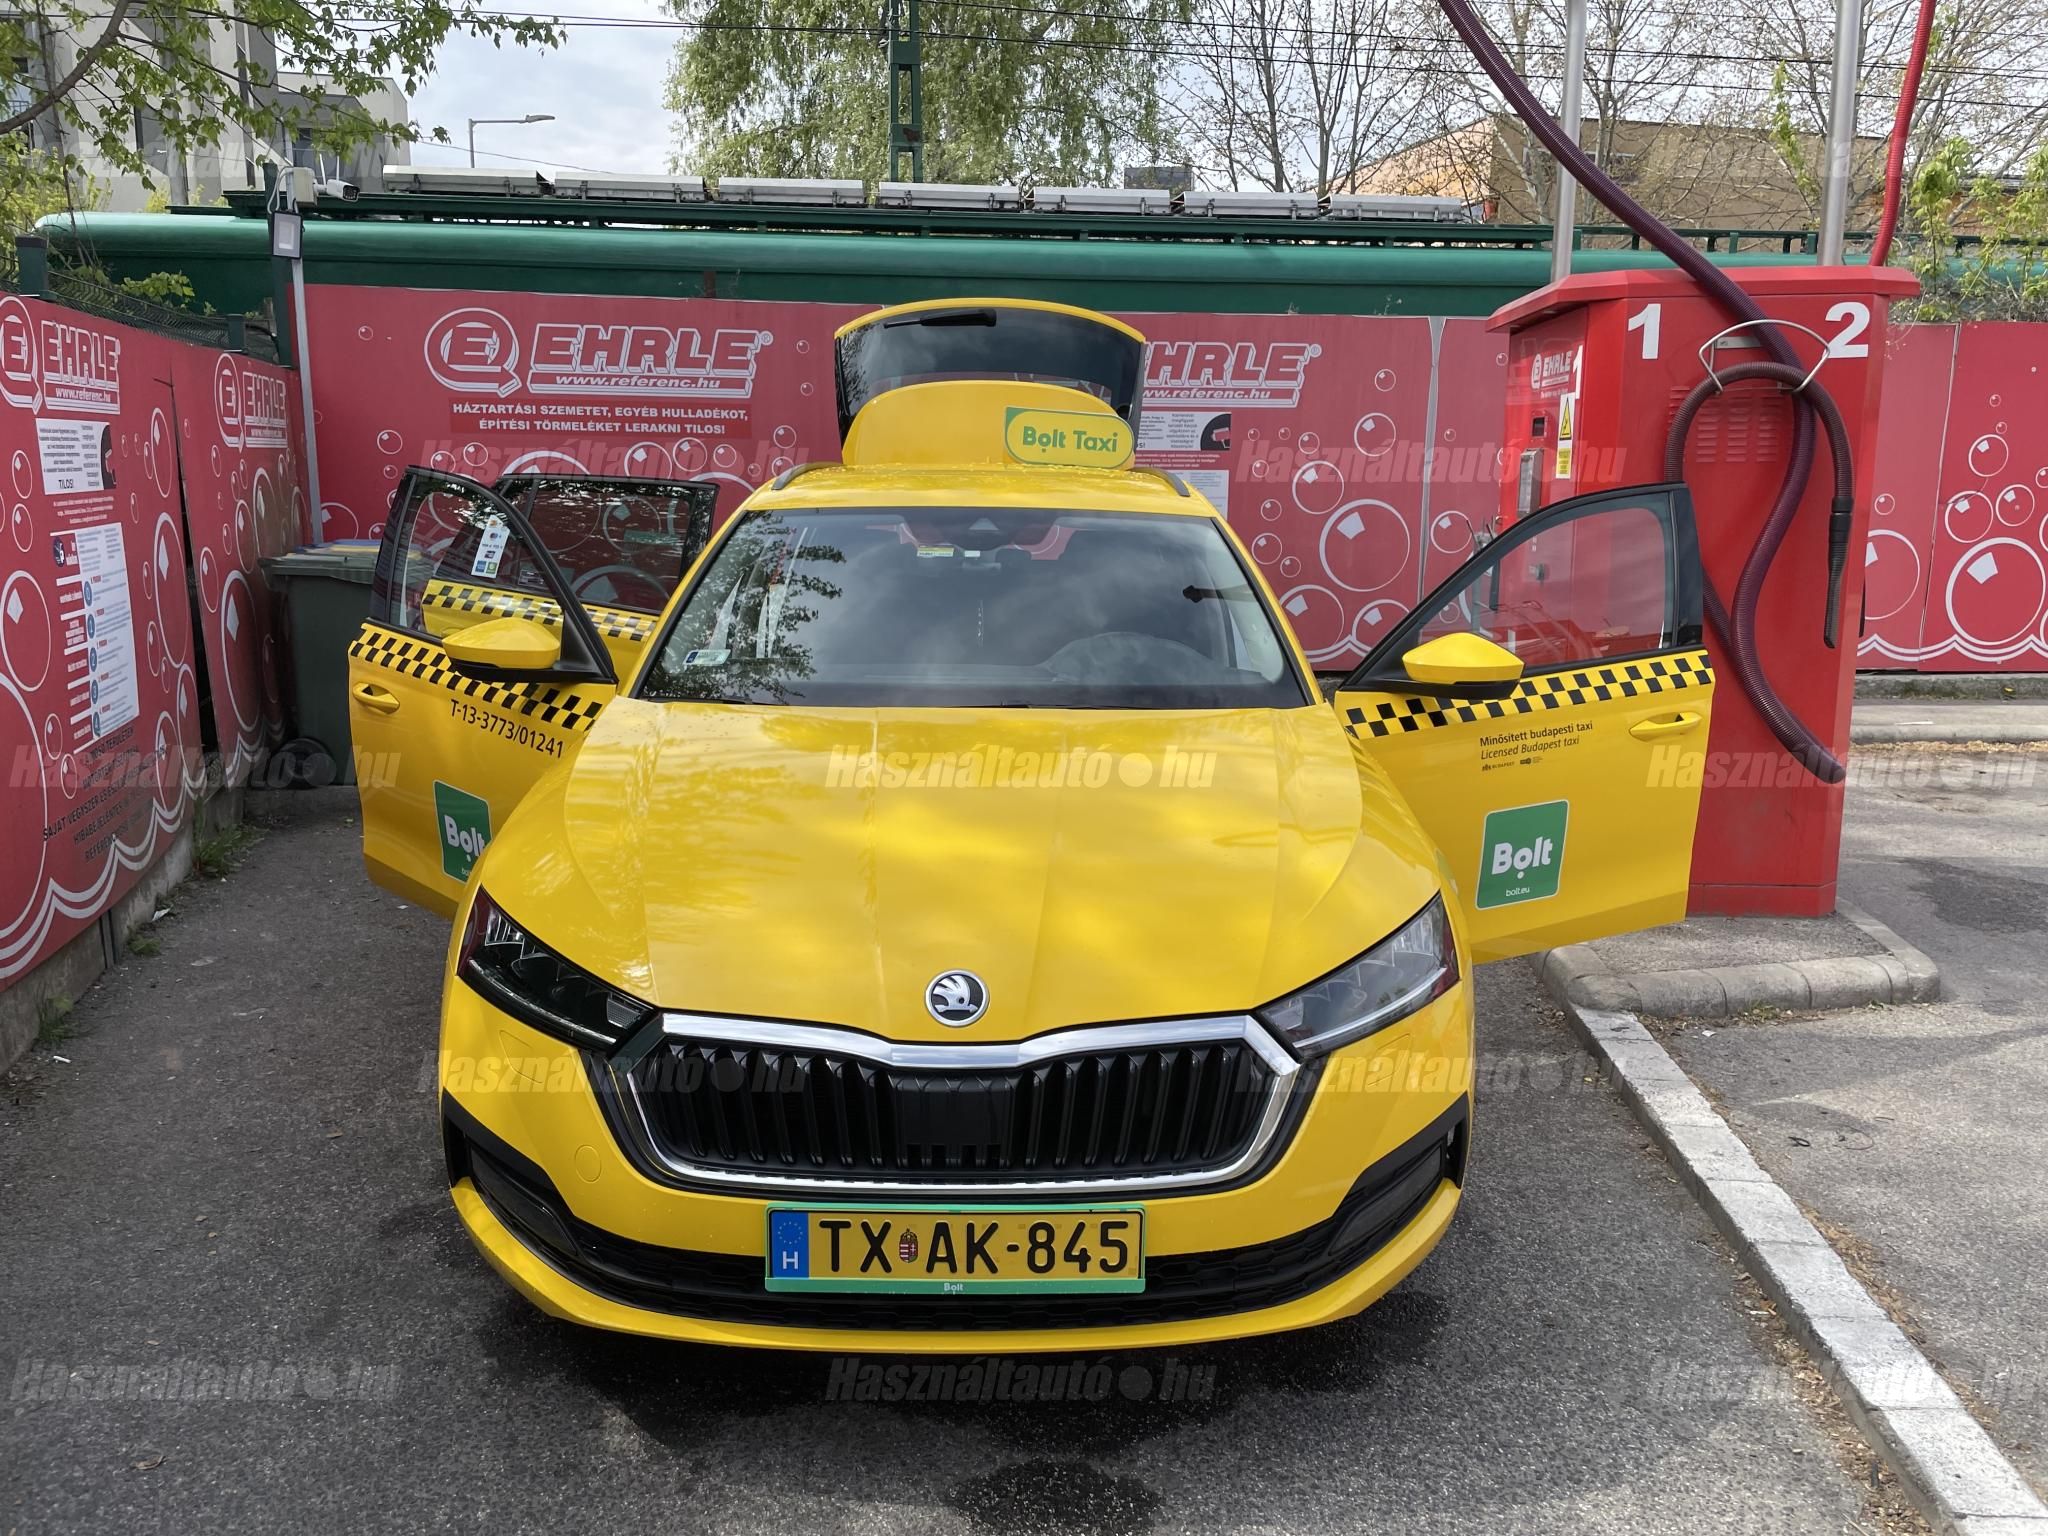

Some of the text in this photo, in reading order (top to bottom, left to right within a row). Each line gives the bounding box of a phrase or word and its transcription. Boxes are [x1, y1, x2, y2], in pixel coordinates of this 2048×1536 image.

[1627, 303, 1662, 360] 1
[1824, 302, 1870, 359] 2
[41, 320, 119, 388] EHRLE
[531, 323, 761, 376] EHRLE
[1144, 342, 1310, 388] HRLE
[1543, 350, 1573, 377] EHRLE
[556, 374, 721, 390] www.referenc.hu
[1573, 345, 1584, 400] 1
[453, 402, 749, 421] HÁZTARTÁSI SZEMETET, EGYÉB HULLADÉKOT,
[1142, 388, 1271, 400] ww.referenc.hu
[479, 418, 726, 435] ÉPÍTÉSI TÖRMELÉKET LERAKNI TILOS!
[1023, 426, 1119, 453] Bolt Taxi
[451, 700, 564, 759] T-13-3773/01241
[1530, 724, 1574, 738] budapesti
[1577, 720, 1593, 732] taxi
[1481, 735, 1580, 760] Licensed Budapest taxi
[444, 814, 486, 862] Bolt
[1492, 836, 1553, 880] Bolt
[1505, 886, 1530, 897] bolt.eu
[782, 1220, 1129, 1274] H TX AK-845
[944, 1283, 964, 1294] Bolt
